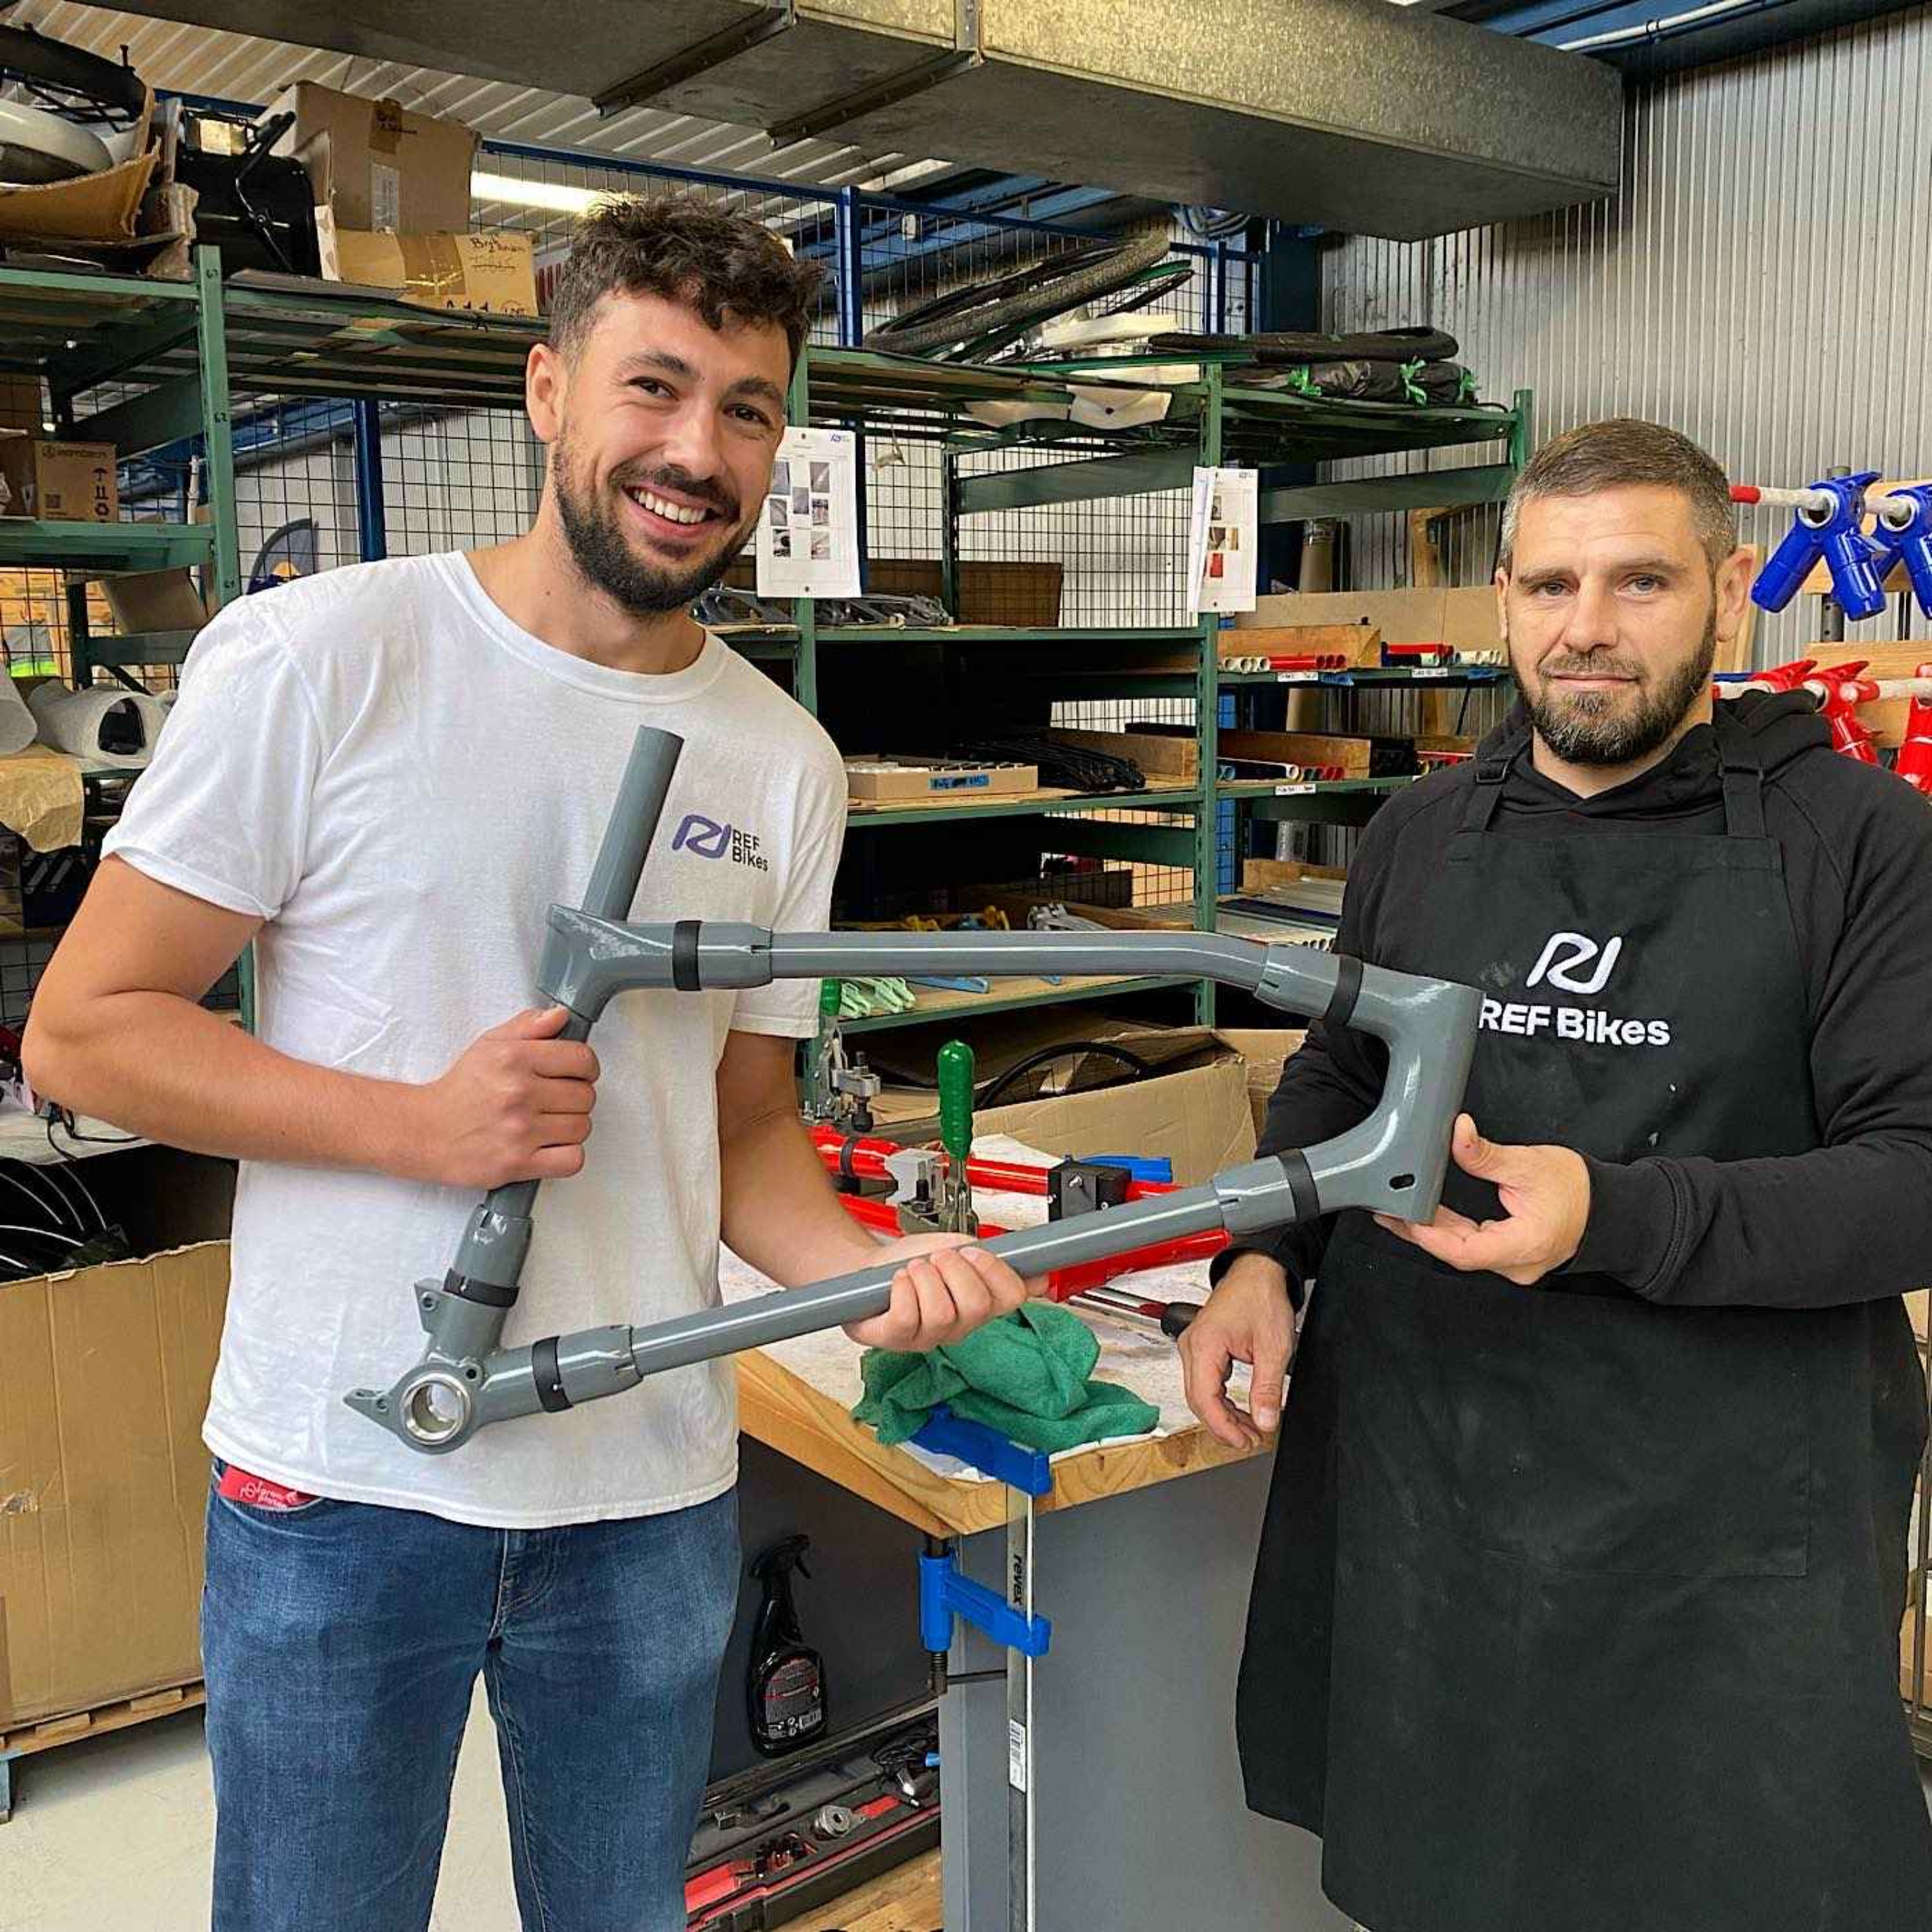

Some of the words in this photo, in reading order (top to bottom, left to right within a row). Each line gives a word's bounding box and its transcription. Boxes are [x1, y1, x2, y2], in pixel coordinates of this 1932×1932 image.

[732, 829, 760, 851] REF
[732, 846, 768, 871] Bikes
[1478, 998, 1551, 1036] REF
[1557, 1007, 1671, 1046] Bikes
